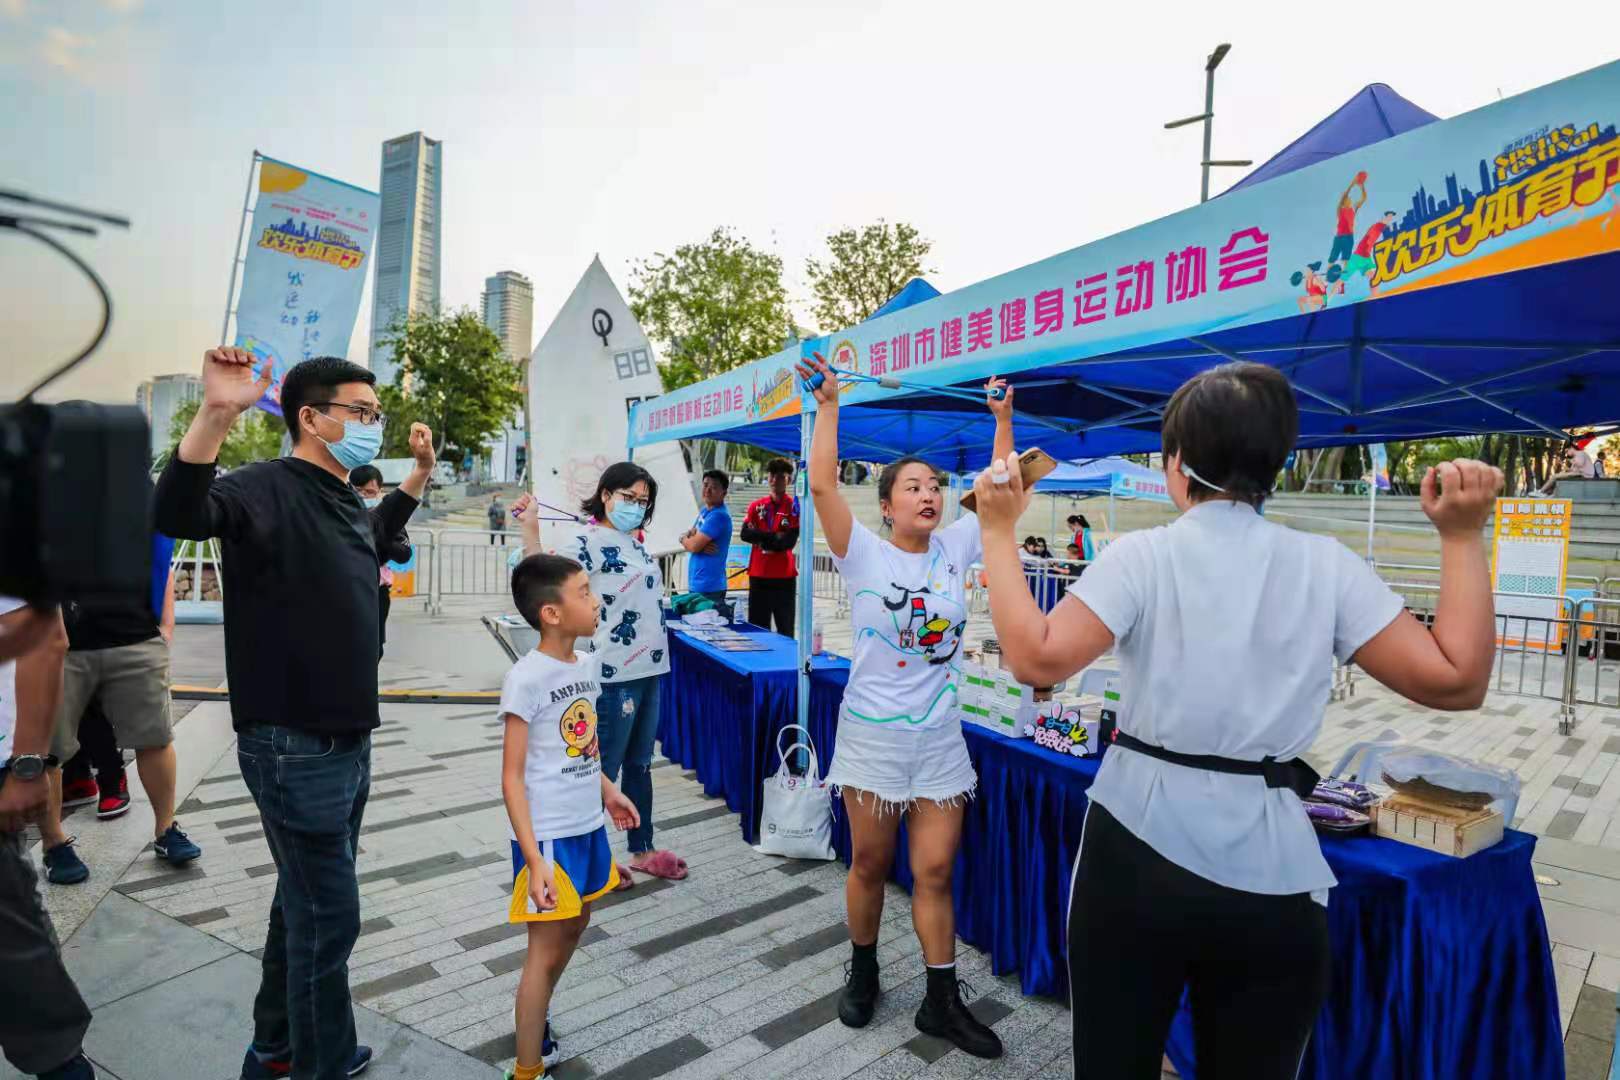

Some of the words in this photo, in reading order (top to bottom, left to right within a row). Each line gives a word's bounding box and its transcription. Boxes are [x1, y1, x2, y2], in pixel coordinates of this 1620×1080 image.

[869, 226, 1270, 377] 深圳市健美健身运动协会
